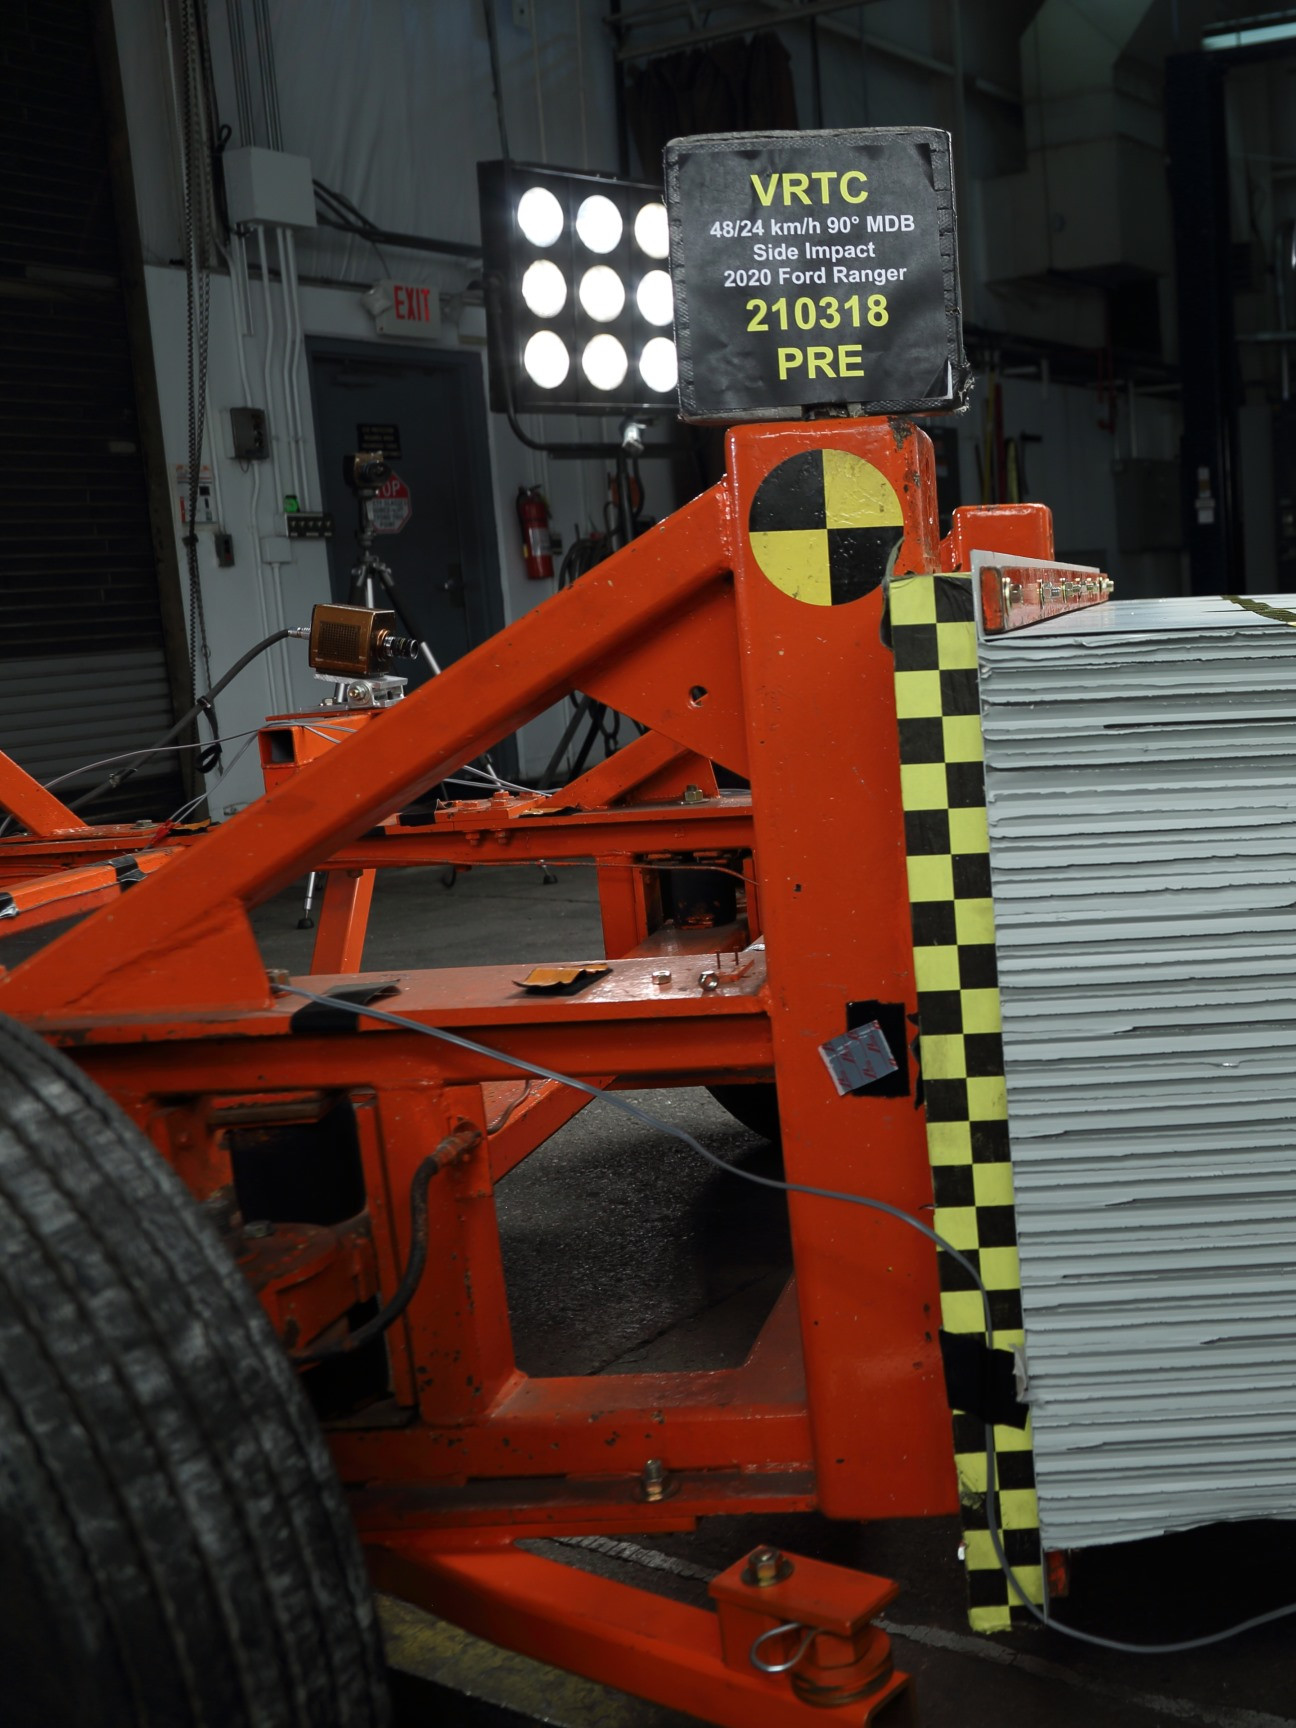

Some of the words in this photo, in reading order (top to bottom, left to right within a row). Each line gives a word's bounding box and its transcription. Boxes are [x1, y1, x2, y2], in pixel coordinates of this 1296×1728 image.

[750, 171, 869, 206] VRTC
[709, 219, 764, 238] 48/24
[771, 217, 821, 236] km/h
[827, 216, 859, 233] 90°
[866, 214, 915, 233] MDB
[753, 243, 799, 261] Side
[805, 241, 876, 262] Impact
[724, 269, 772, 288] 2020
[778, 266, 826, 285] Ford
[833, 265, 907, 286] Ranger
[394, 285, 430, 321] EXIT
[746, 293, 889, 332] 210318
[777, 344, 865, 380] PRE
